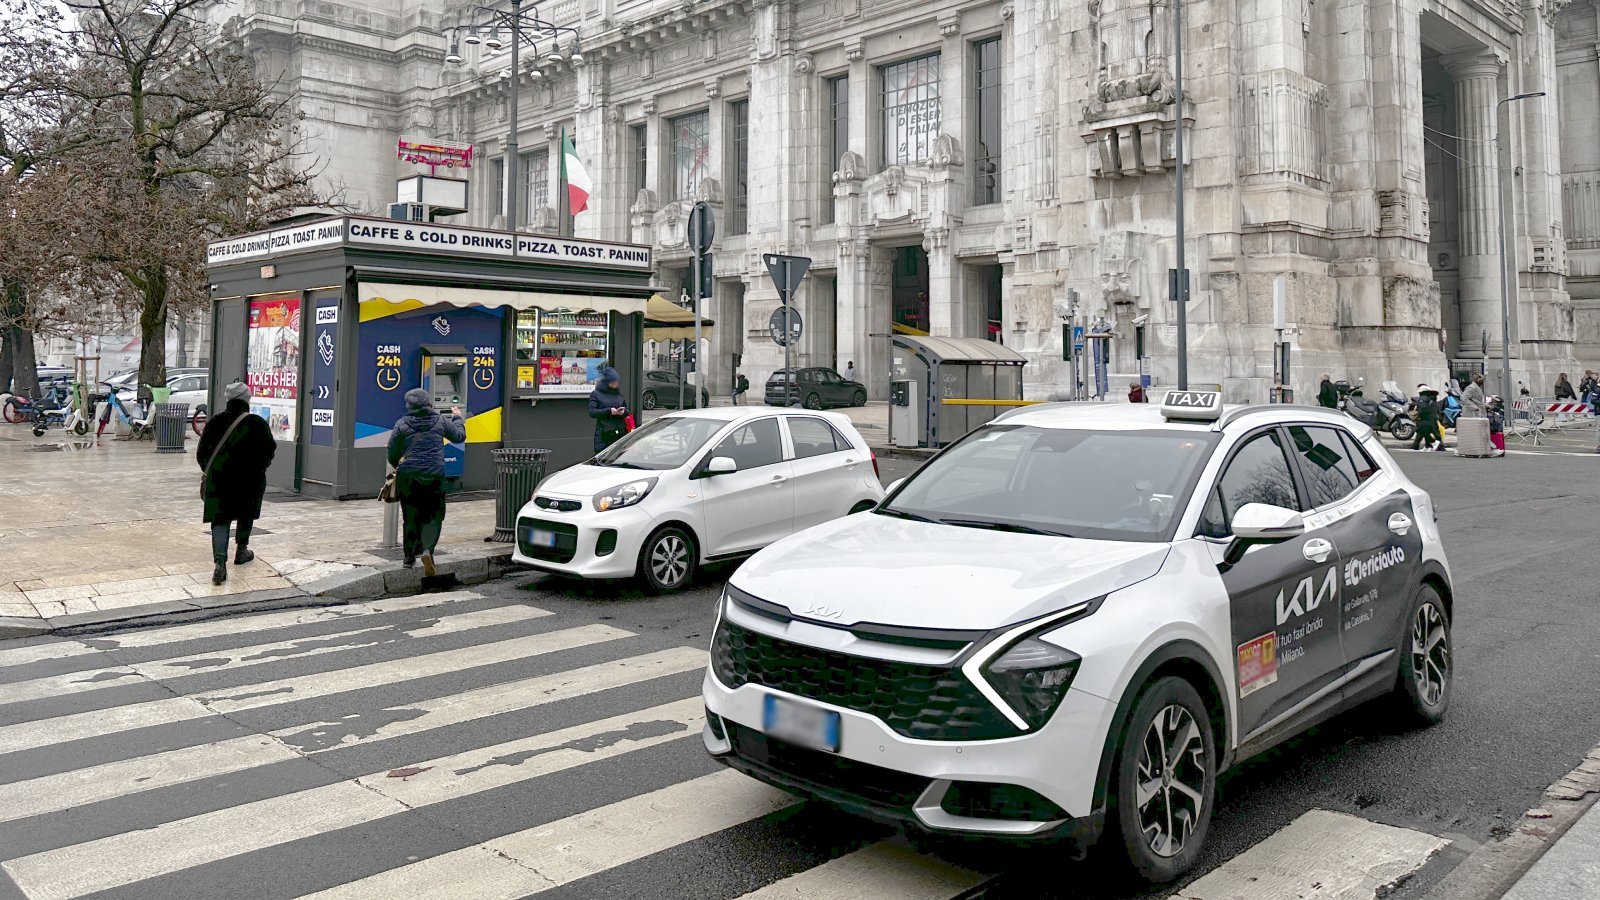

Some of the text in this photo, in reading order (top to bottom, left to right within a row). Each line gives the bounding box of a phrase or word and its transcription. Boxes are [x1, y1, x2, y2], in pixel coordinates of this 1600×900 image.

[318, 225, 343, 240] PANINI
[350, 224, 513, 249] CAFFE & COLD DRINKS
[208, 239, 269, 257] CAFFE & COLD DRINKS
[518, 241, 648, 262] PIZZA, TOAST, PANINI
[318, 309, 336, 320] CASH
[377, 345, 401, 354] CASH
[473, 346, 495, 355] CASH
[376, 355, 401, 367] 24h
[473, 356, 495, 367] 24h
[248, 371, 279, 386] TICKETS
[1170, 393, 1214, 406] TAXI
[314, 412, 332, 423] CASH
[1350, 545, 1405, 586] Clericiauto
[1275, 566, 1337, 626] KIA
[1281, 633, 1292, 646] tuo
[1293, 624, 1305, 641] taxi
[1305, 617, 1324, 635] ibrido
[1281, 646, 1305, 665] Milano.
